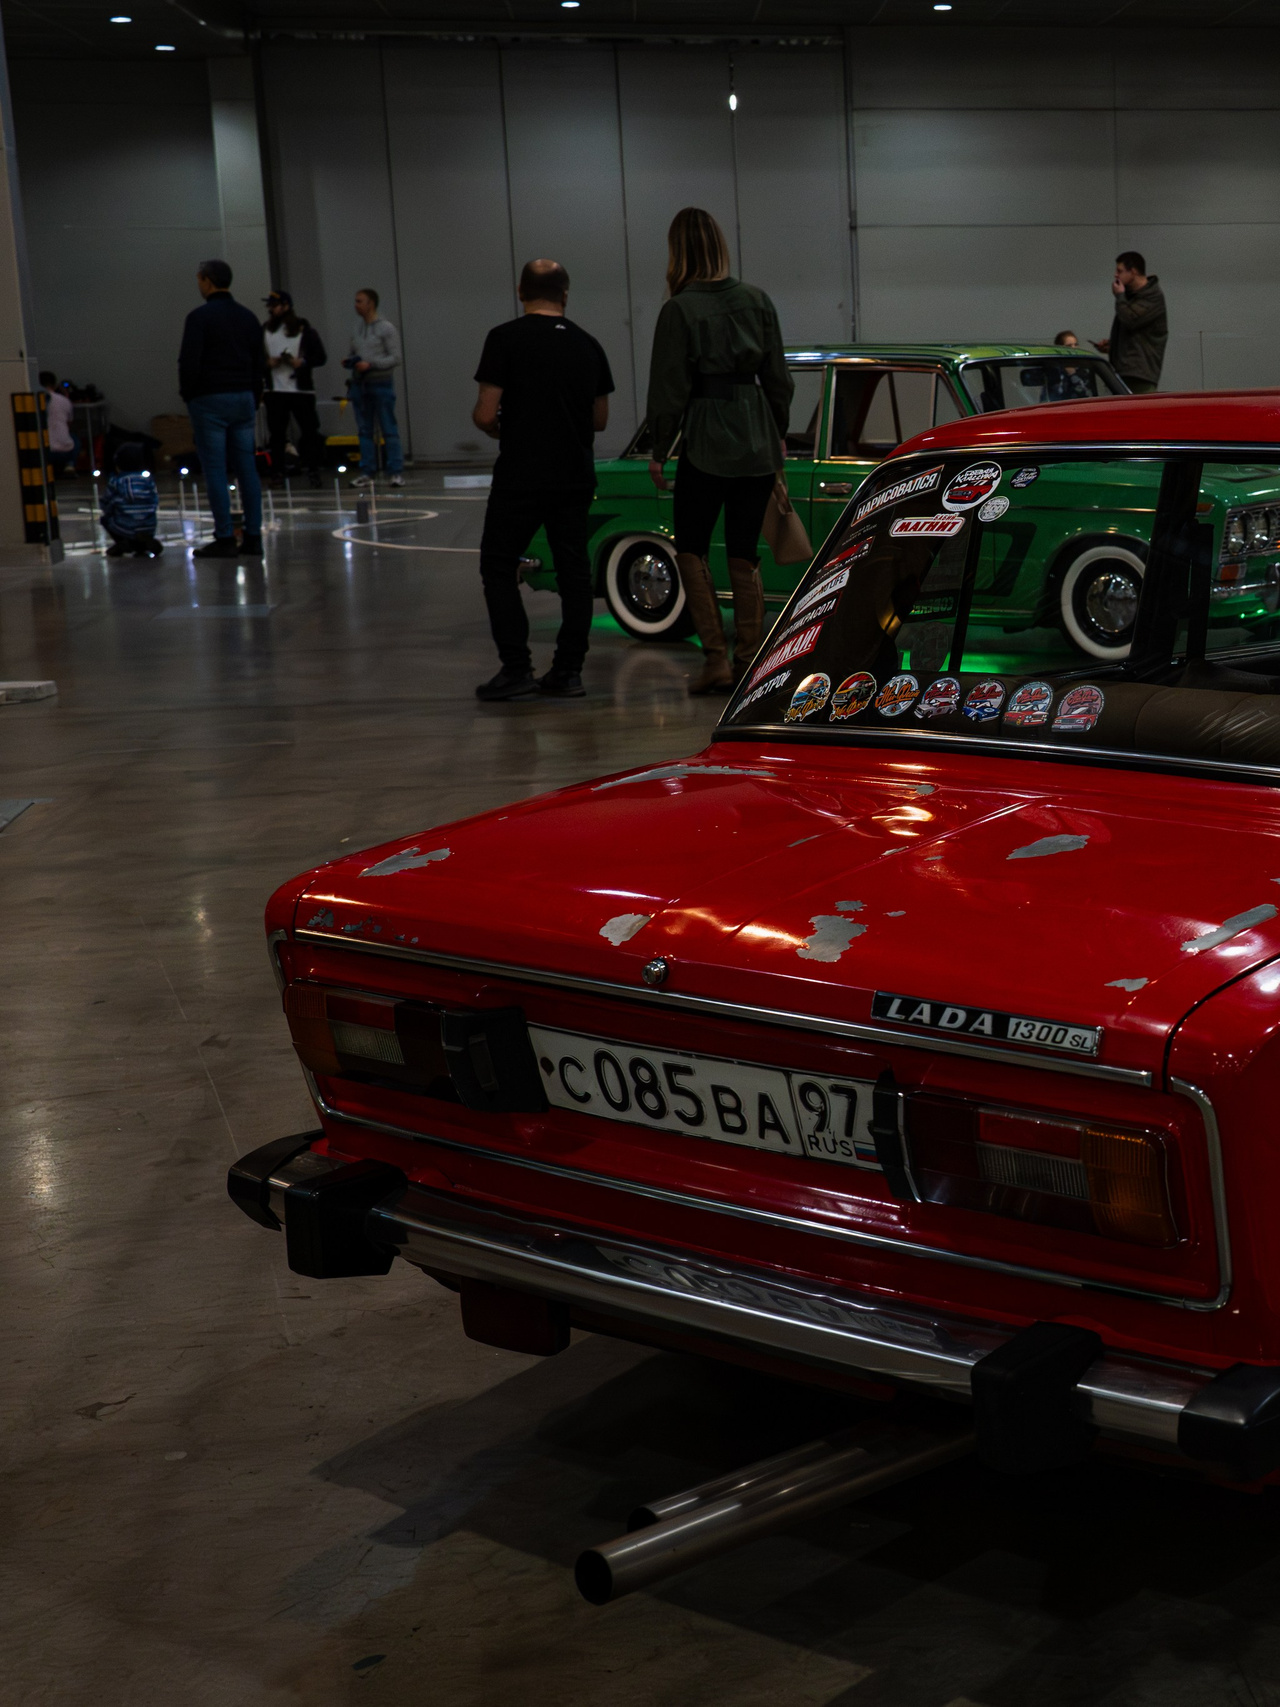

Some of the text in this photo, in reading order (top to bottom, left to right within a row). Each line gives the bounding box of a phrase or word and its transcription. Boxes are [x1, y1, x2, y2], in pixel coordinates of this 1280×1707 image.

[856, 472, 938, 520] НАРИСОВАЛСЯ
[895, 521, 961, 532] МАГНИТ
[886, 998, 993, 1035] LADA
[1011, 1020, 1068, 1044] 1300
[798, 1081, 857, 1138] 97
[808, 1134, 854, 1157] RUS
